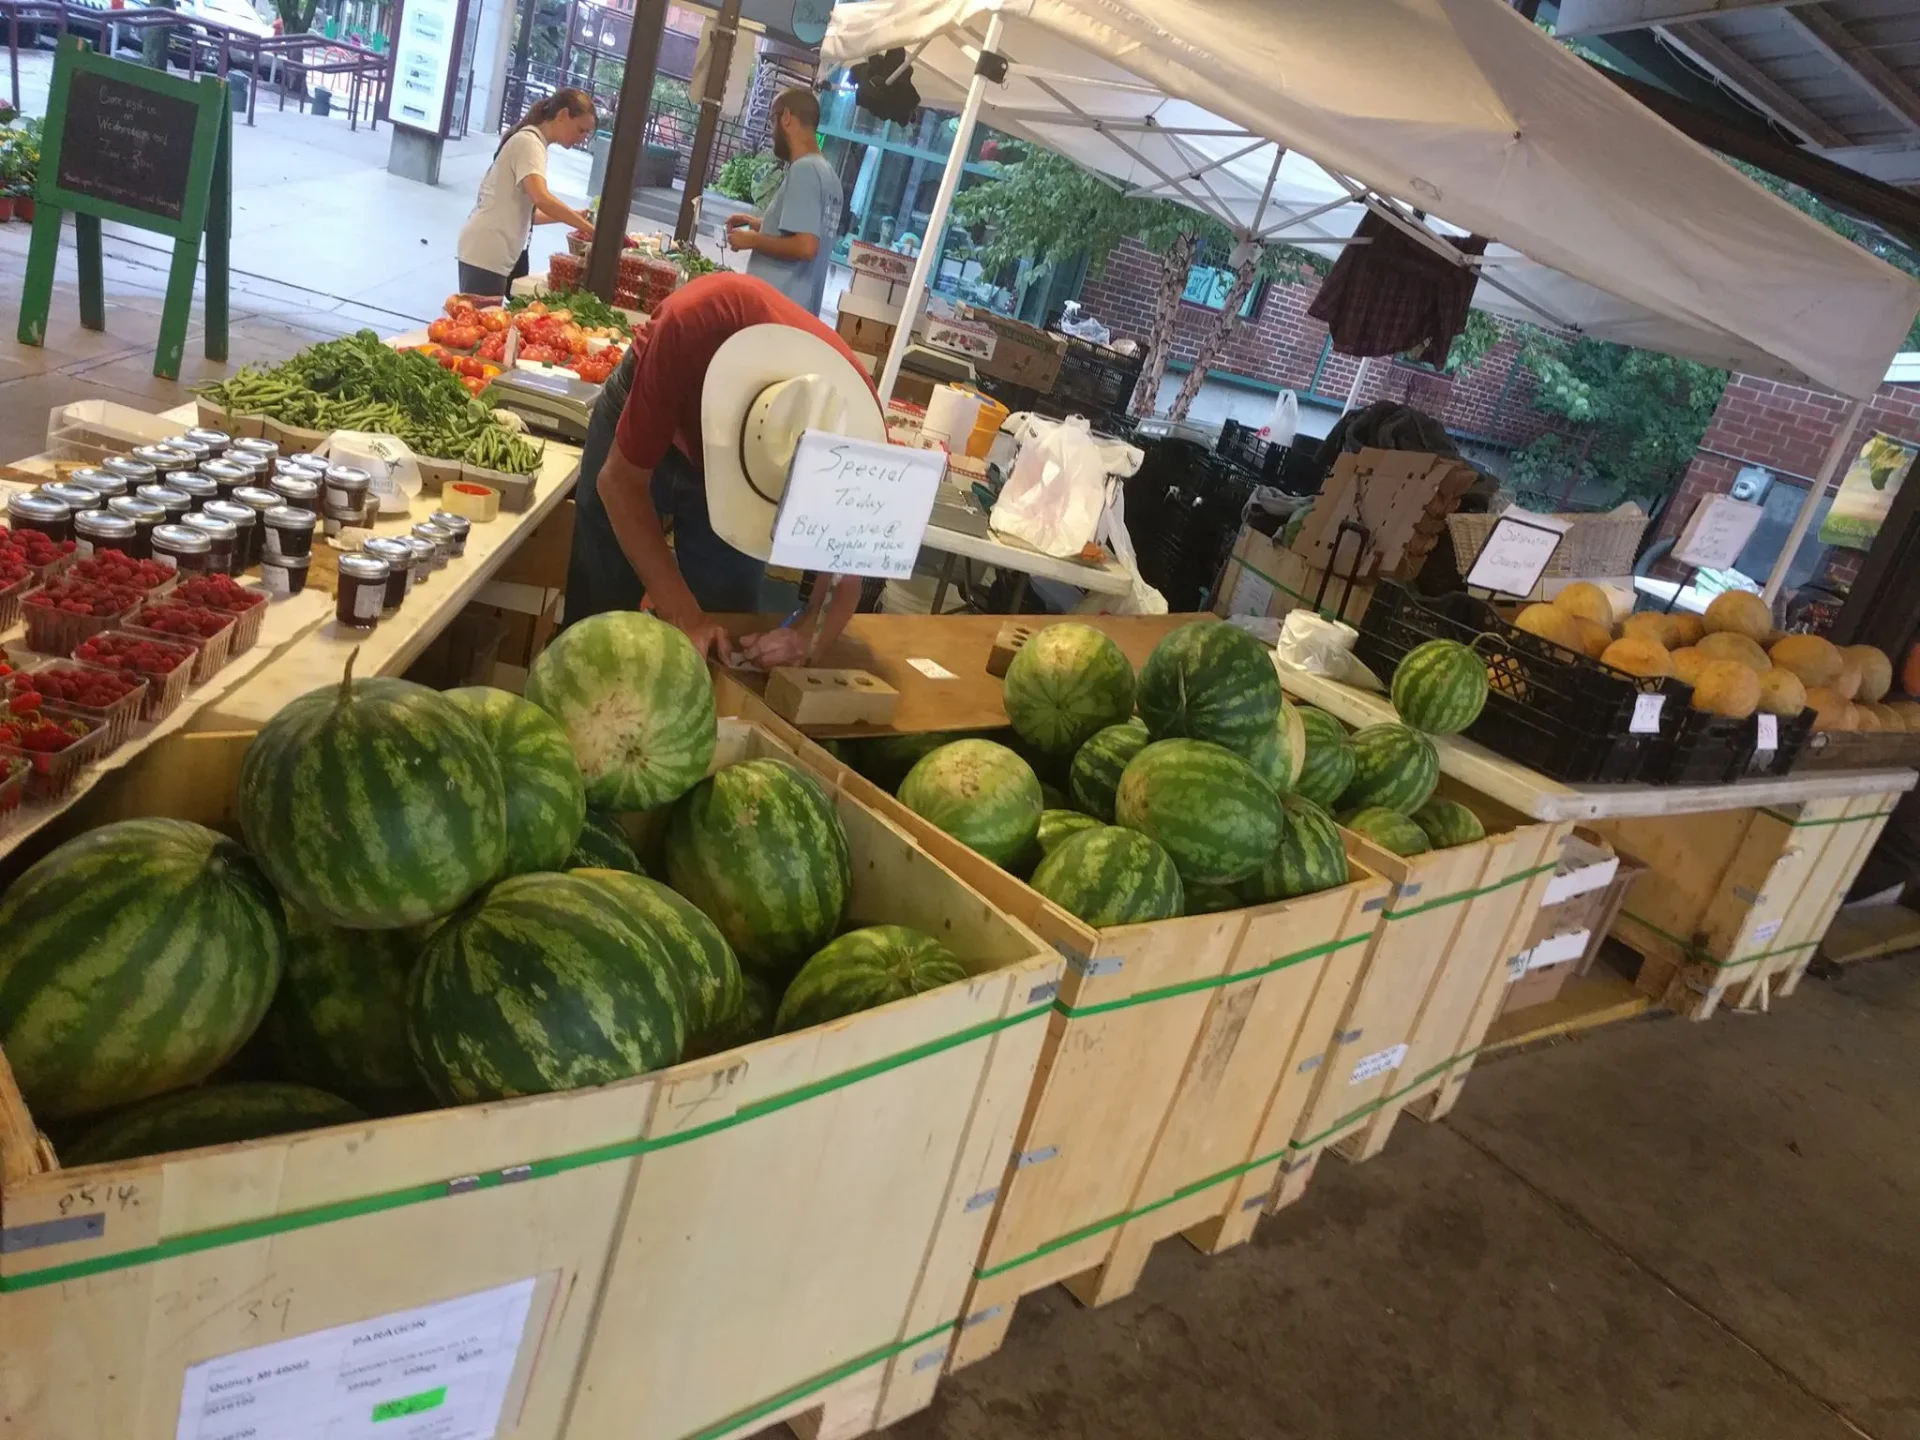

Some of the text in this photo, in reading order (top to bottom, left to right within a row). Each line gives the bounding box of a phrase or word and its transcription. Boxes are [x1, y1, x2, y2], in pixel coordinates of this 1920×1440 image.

[813, 445, 913, 483] Special
[834, 486, 886, 515] Today
[791, 514, 830, 548] Buy
